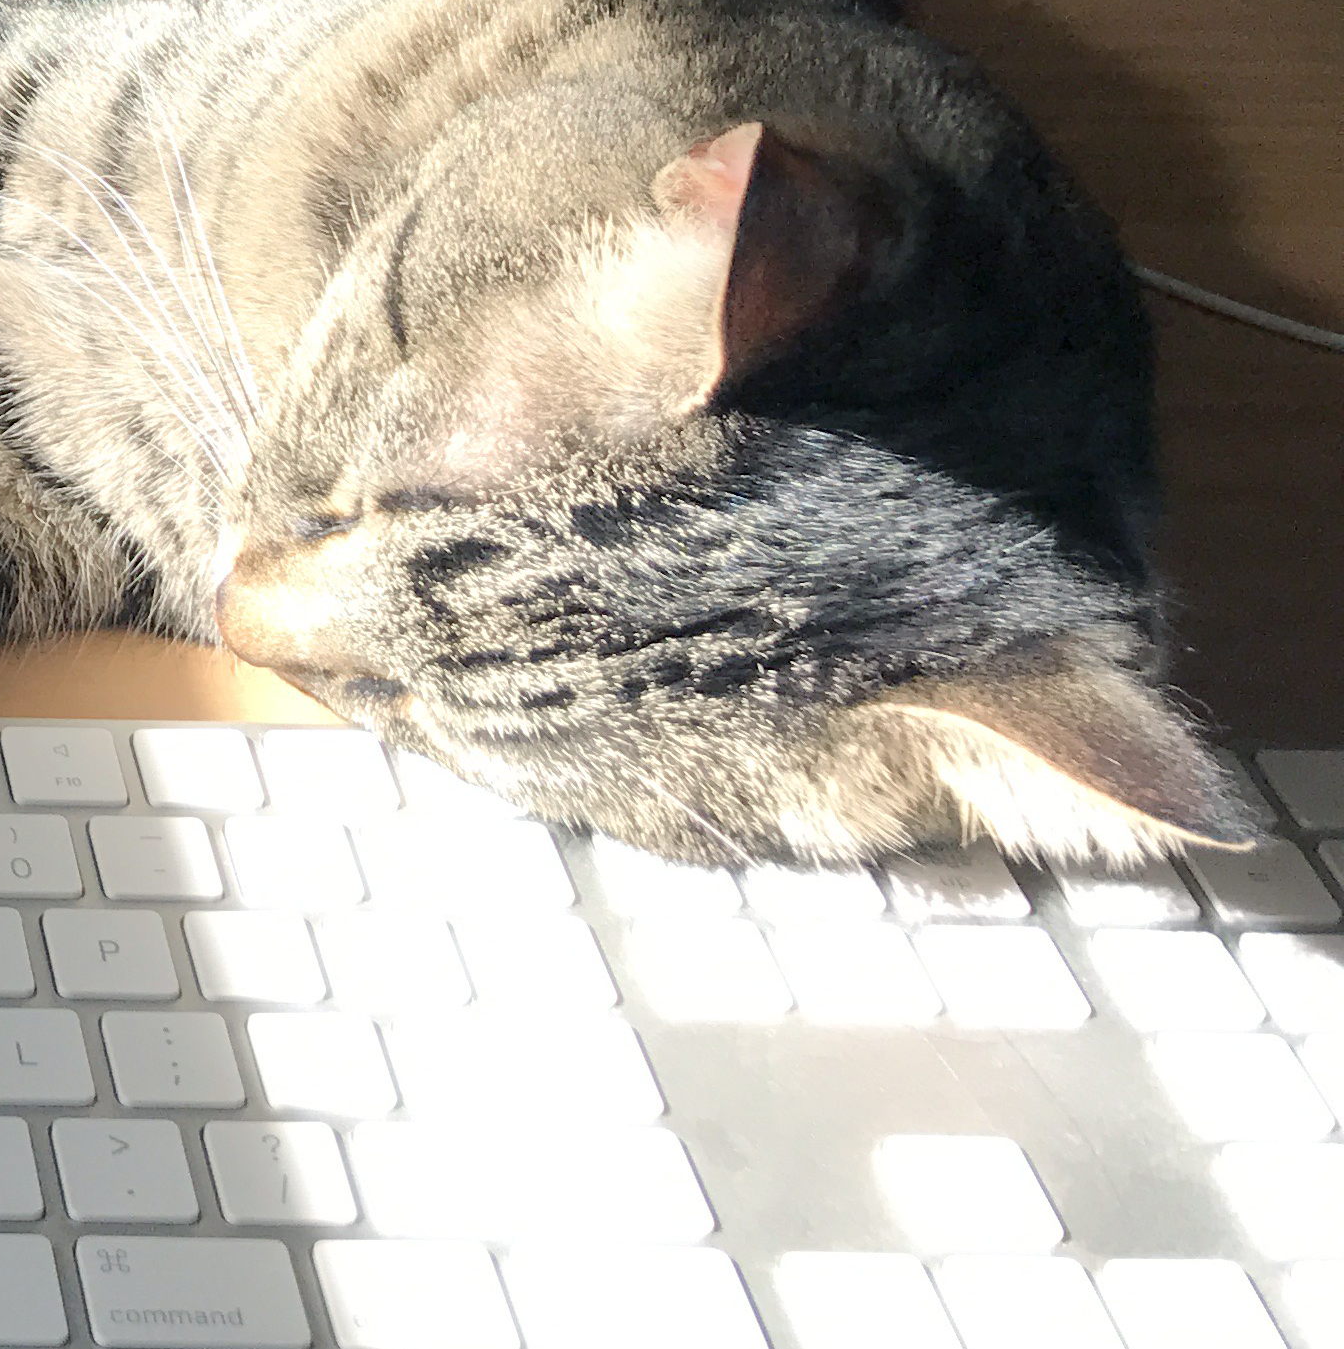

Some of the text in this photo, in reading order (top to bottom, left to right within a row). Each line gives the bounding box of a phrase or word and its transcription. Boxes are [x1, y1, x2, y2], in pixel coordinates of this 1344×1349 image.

[54, 776, 82, 787] F10
[10, 857, 33, 879] 0
[98, 939, 120, 963] P
[15, 1041, 38, 1066] L
[109, 1303, 245, 1329] command
